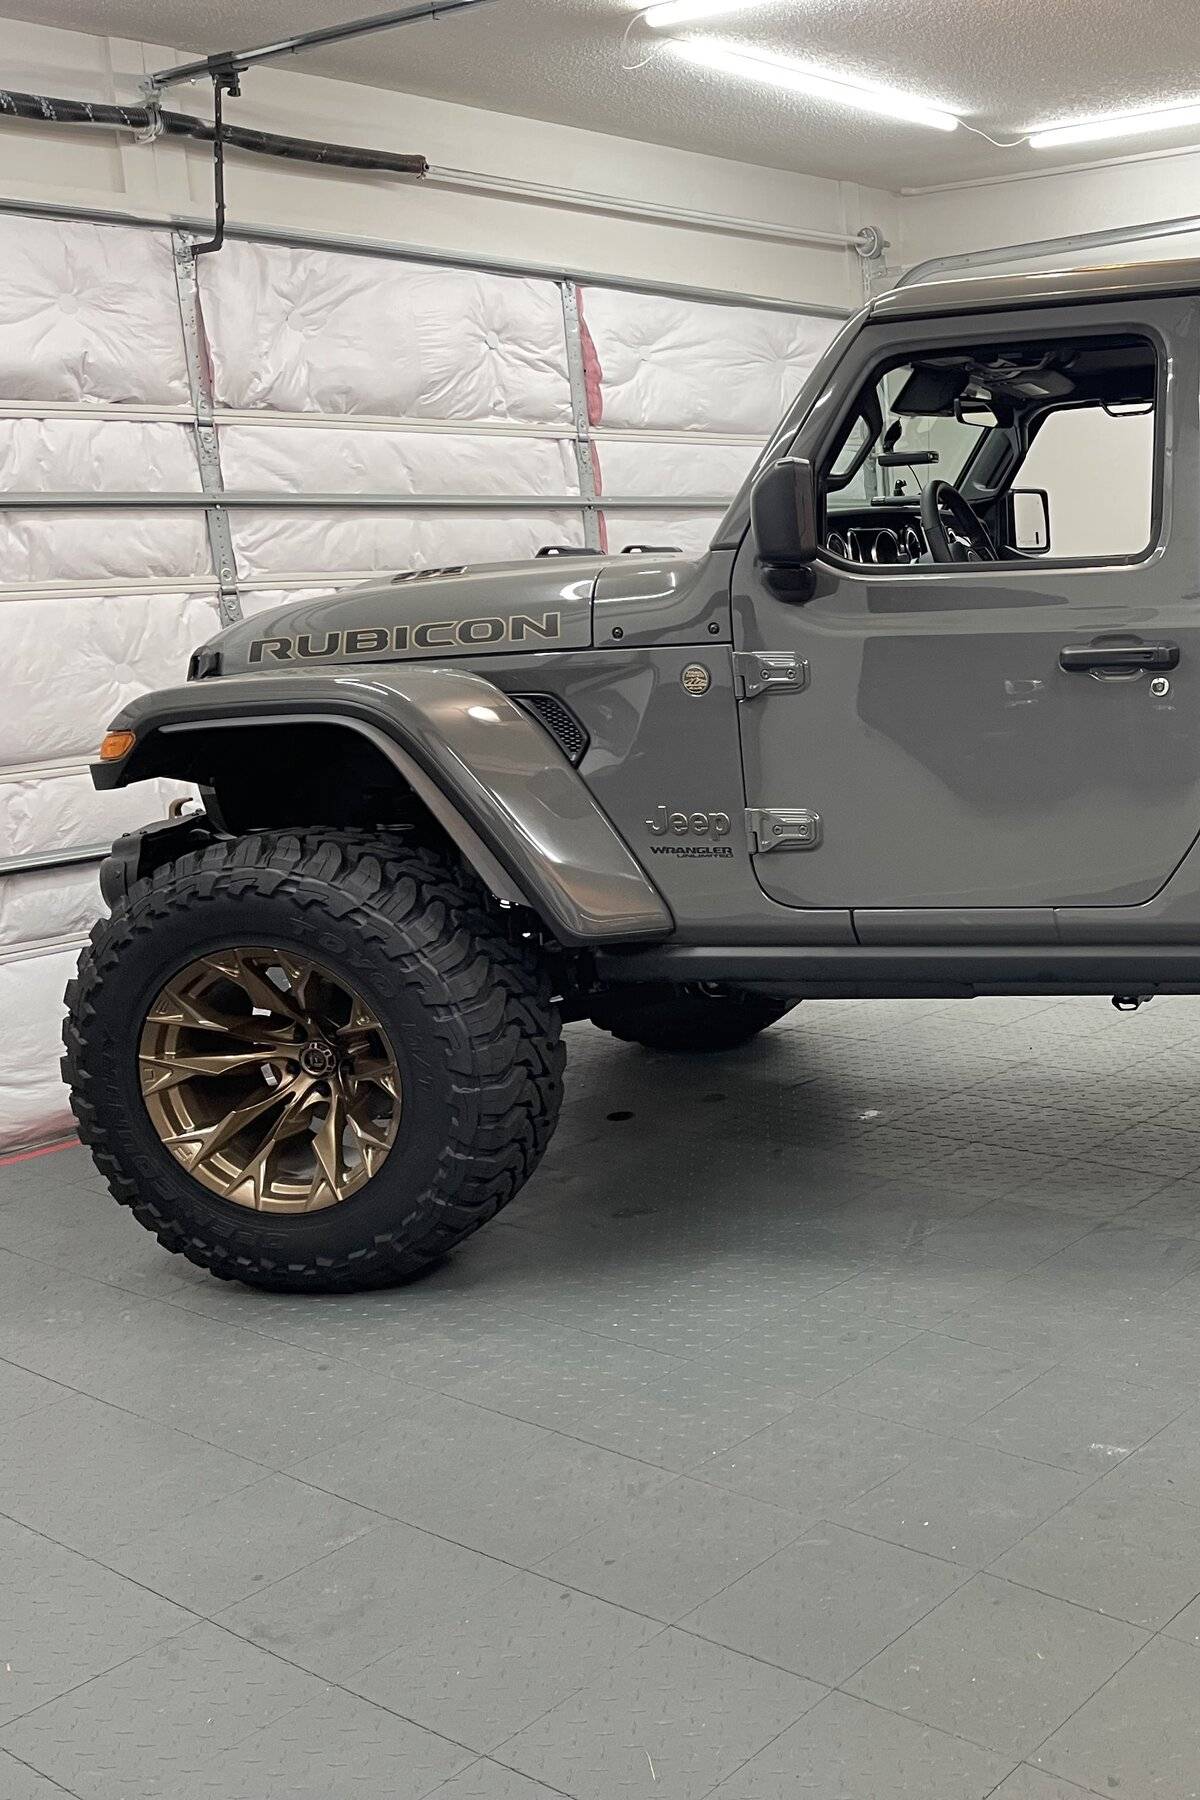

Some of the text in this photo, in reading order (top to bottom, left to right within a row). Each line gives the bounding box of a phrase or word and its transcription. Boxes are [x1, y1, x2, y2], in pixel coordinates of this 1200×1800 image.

[248, 611, 561, 664] RUBICON
[645, 804, 732, 842] Jeep
[649, 846, 733, 854] WRANGLER
